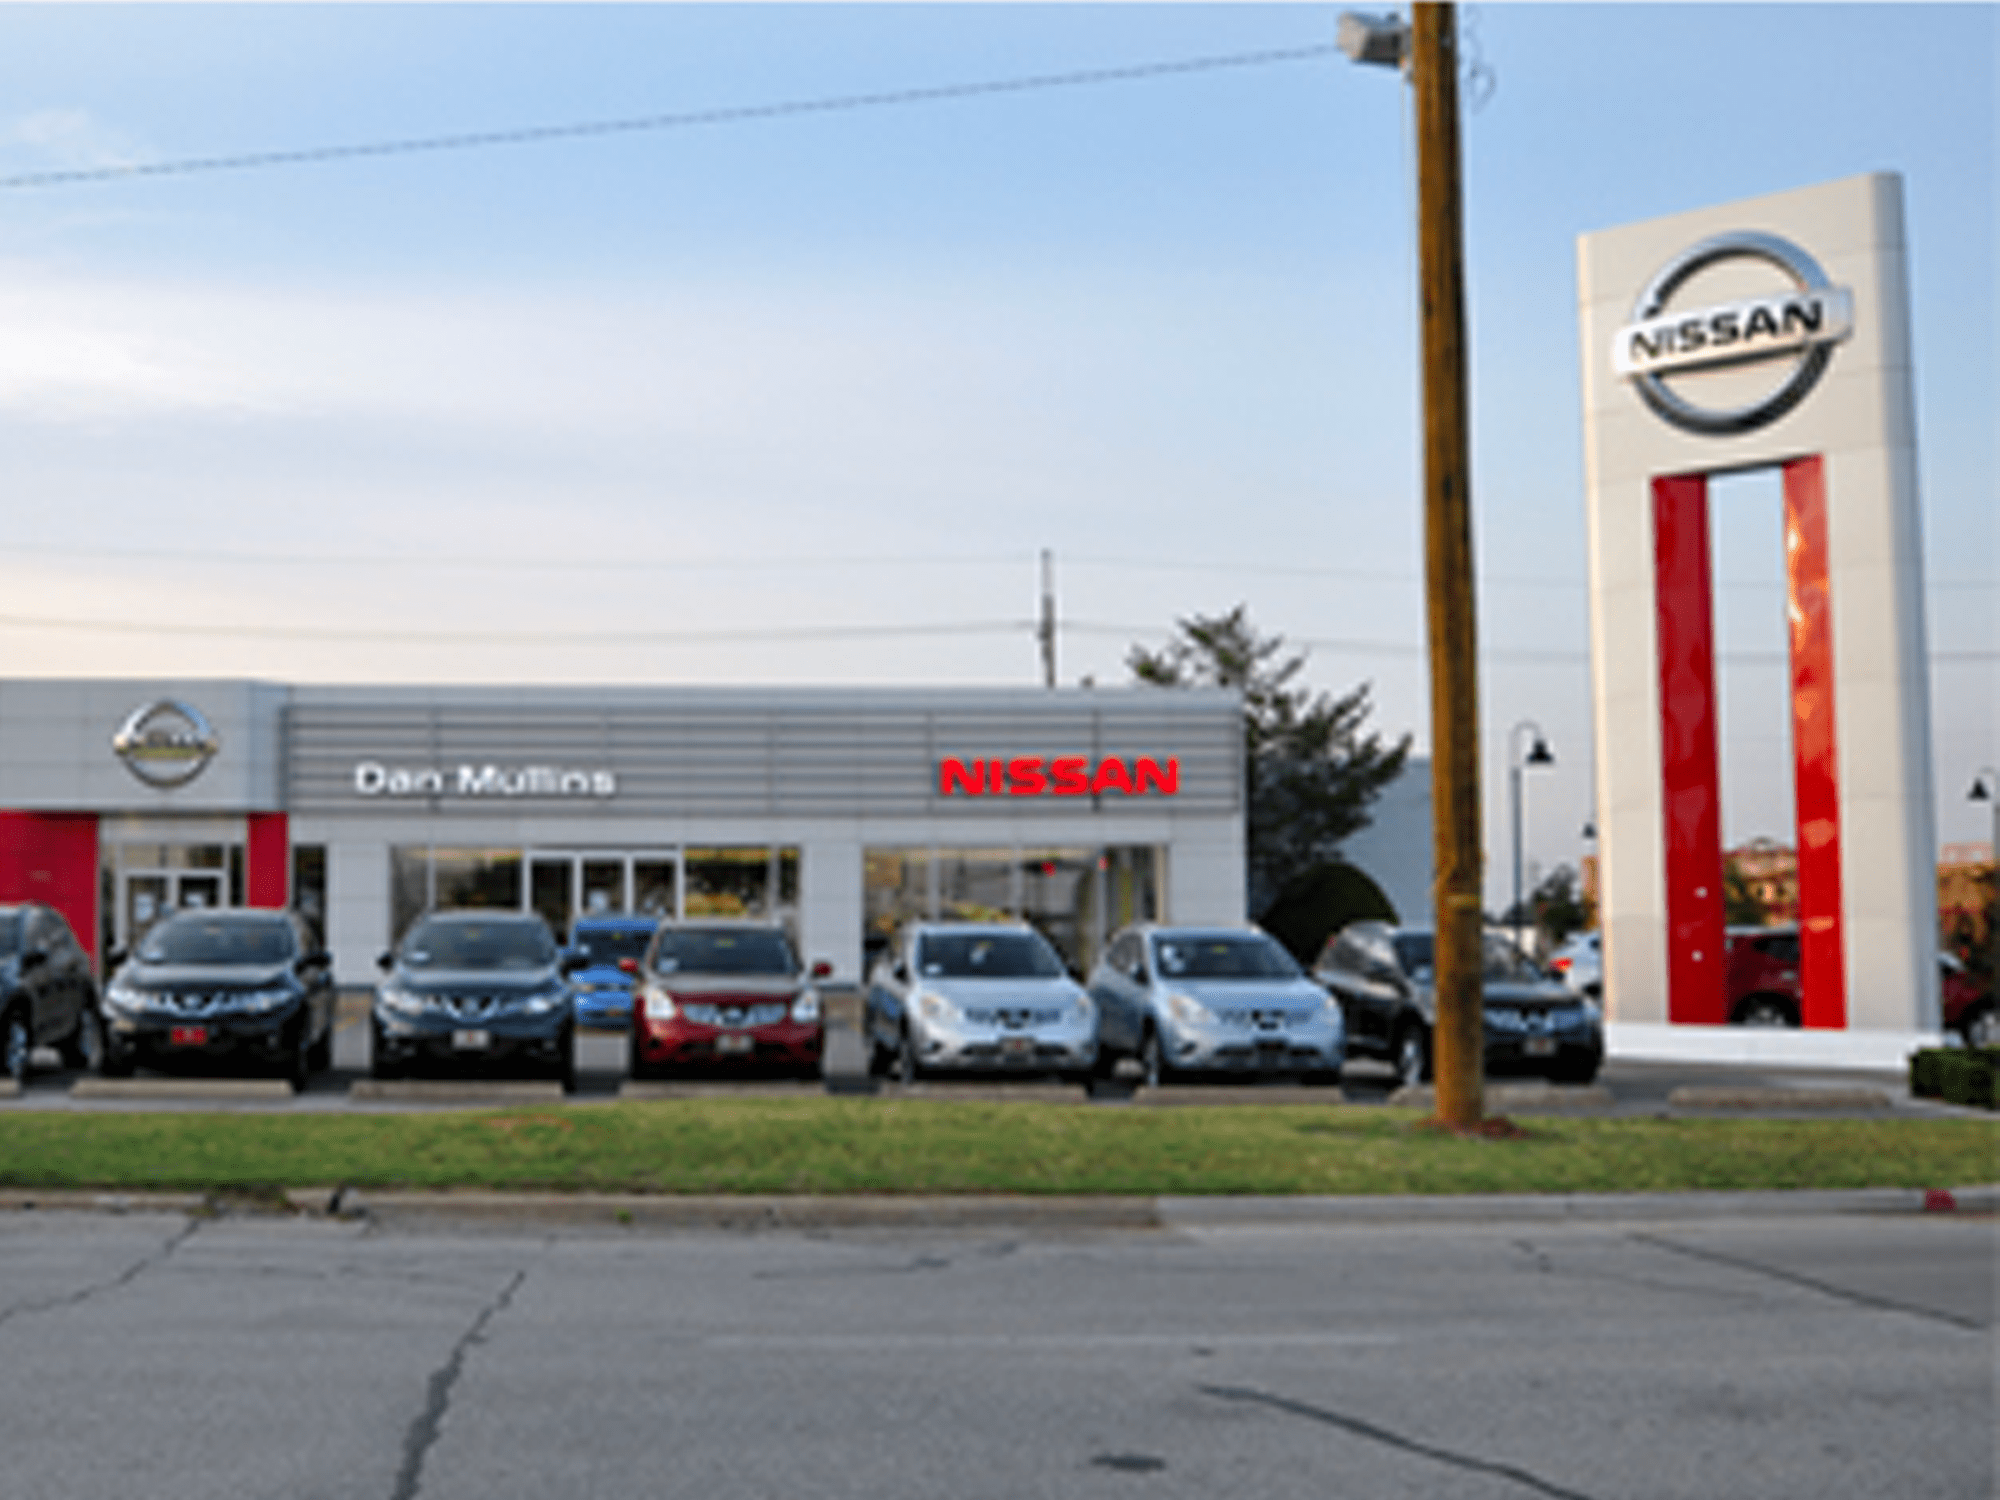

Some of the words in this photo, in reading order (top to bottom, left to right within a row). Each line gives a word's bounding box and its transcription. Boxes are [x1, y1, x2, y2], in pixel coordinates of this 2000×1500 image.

[1629, 299, 1823, 359] NISSAN
[354, 760, 443, 794] Dan
[456, 762, 616, 794] Mullins
[939, 755, 1181, 796] NISSAN
